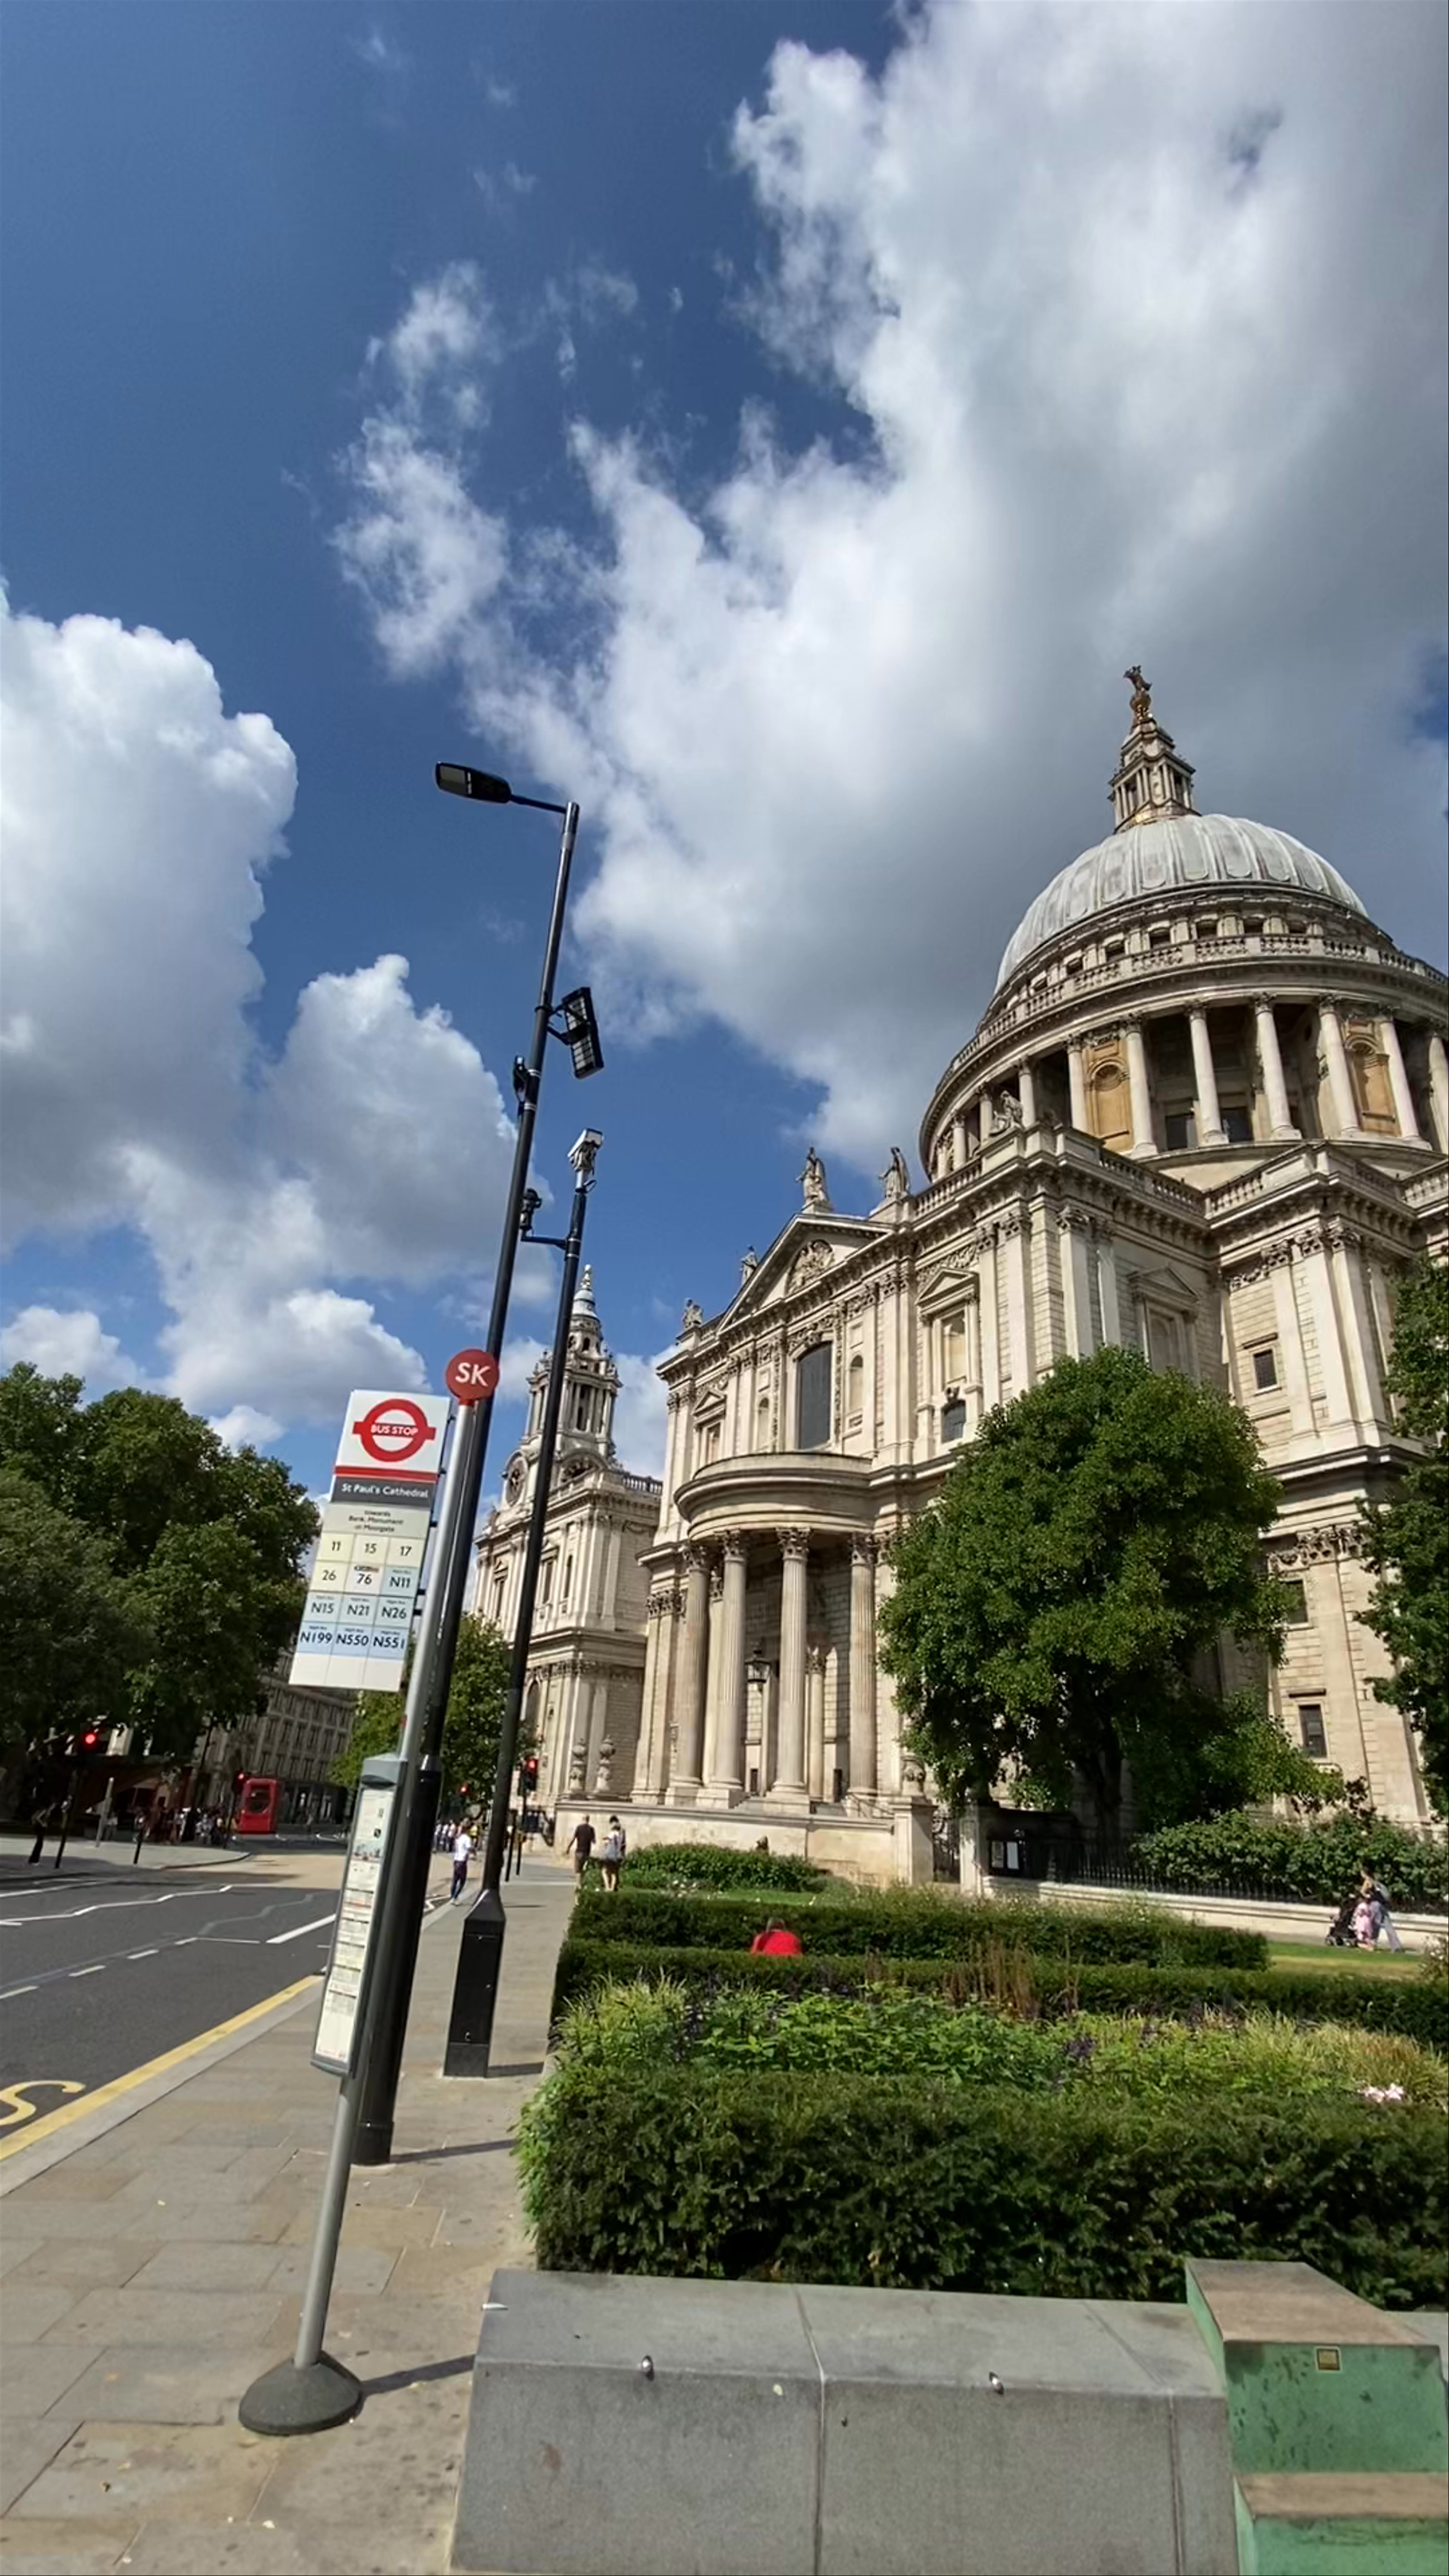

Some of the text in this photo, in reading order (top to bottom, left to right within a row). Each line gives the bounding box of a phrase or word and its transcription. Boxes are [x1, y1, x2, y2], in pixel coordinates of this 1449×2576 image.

[455, 1362, 490, 1387] SK
[371, 1425, 418, 1435] BUS STOP
[342, 1483, 428, 1498] St Paul's Cathedral
[332, 1541, 341, 1551] 11
[365, 1543, 377, 1554] 15
[400, 1546, 412, 1556] 17
[322, 1570, 336, 1581] 26
[357, 1573, 372, 1584] 76
[389, 1576, 411, 1588] N11
[311, 1602, 334, 1614] N15
[346, 1604, 370, 1616] N21
[381, 1606, 407, 1619] N26
[300, 1631, 332, 1643] N199
[336, 1634, 369, 1646] N550
[373, 1636, 405, 1649] N551
